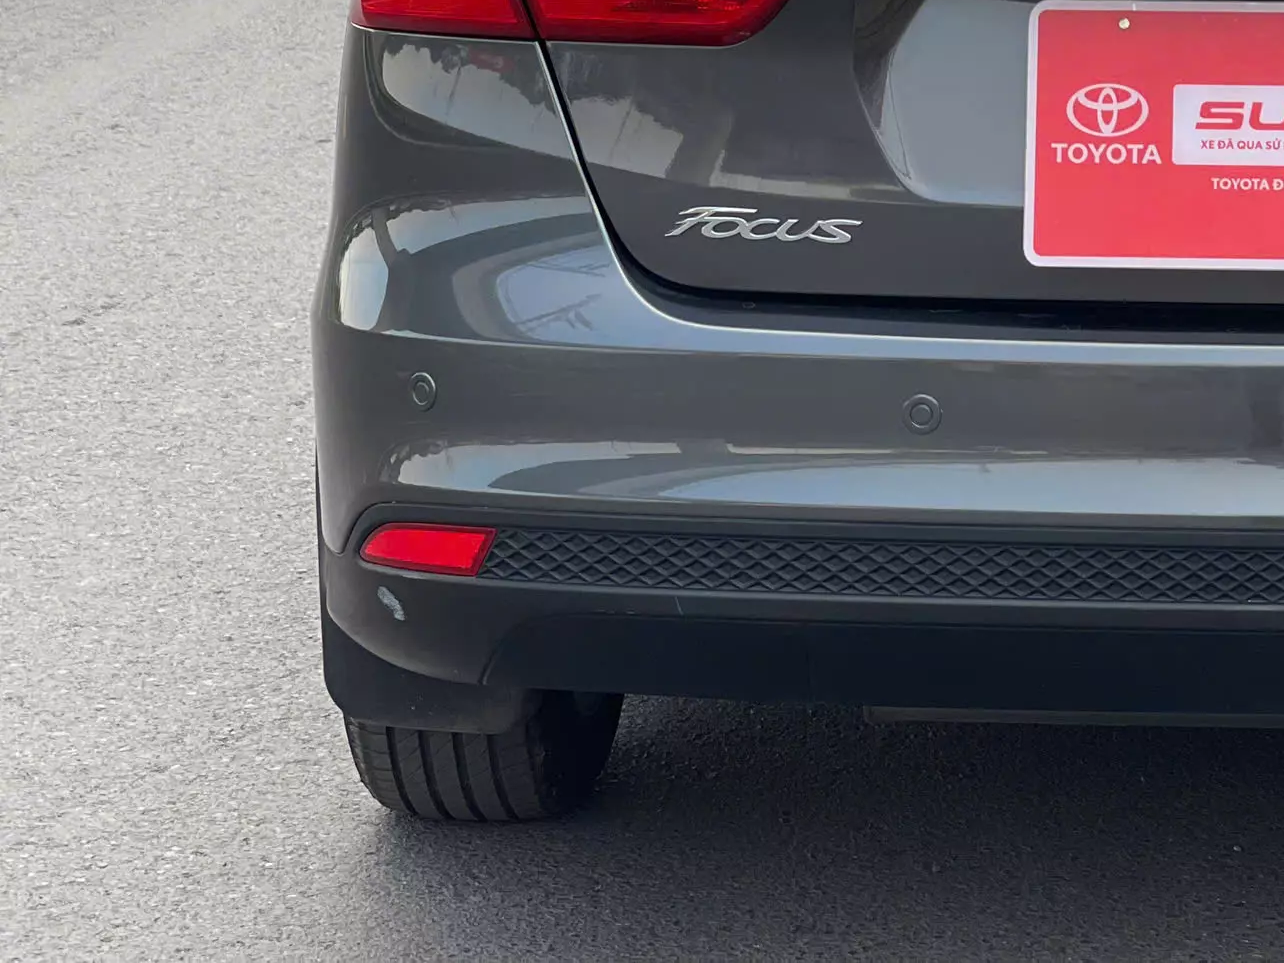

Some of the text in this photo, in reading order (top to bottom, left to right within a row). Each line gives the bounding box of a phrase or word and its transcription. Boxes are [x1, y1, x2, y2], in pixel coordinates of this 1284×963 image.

[1200, 140, 1216, 150] XE
[1217, 138, 1235, 150] ĐÃ
[1236, 140, 1263, 151] QUA
[1265, 137, 1282, 151] SỬ
[1050, 142, 1162, 164] TOYOTA
[1211, 177, 1269, 190] TOYOTA
